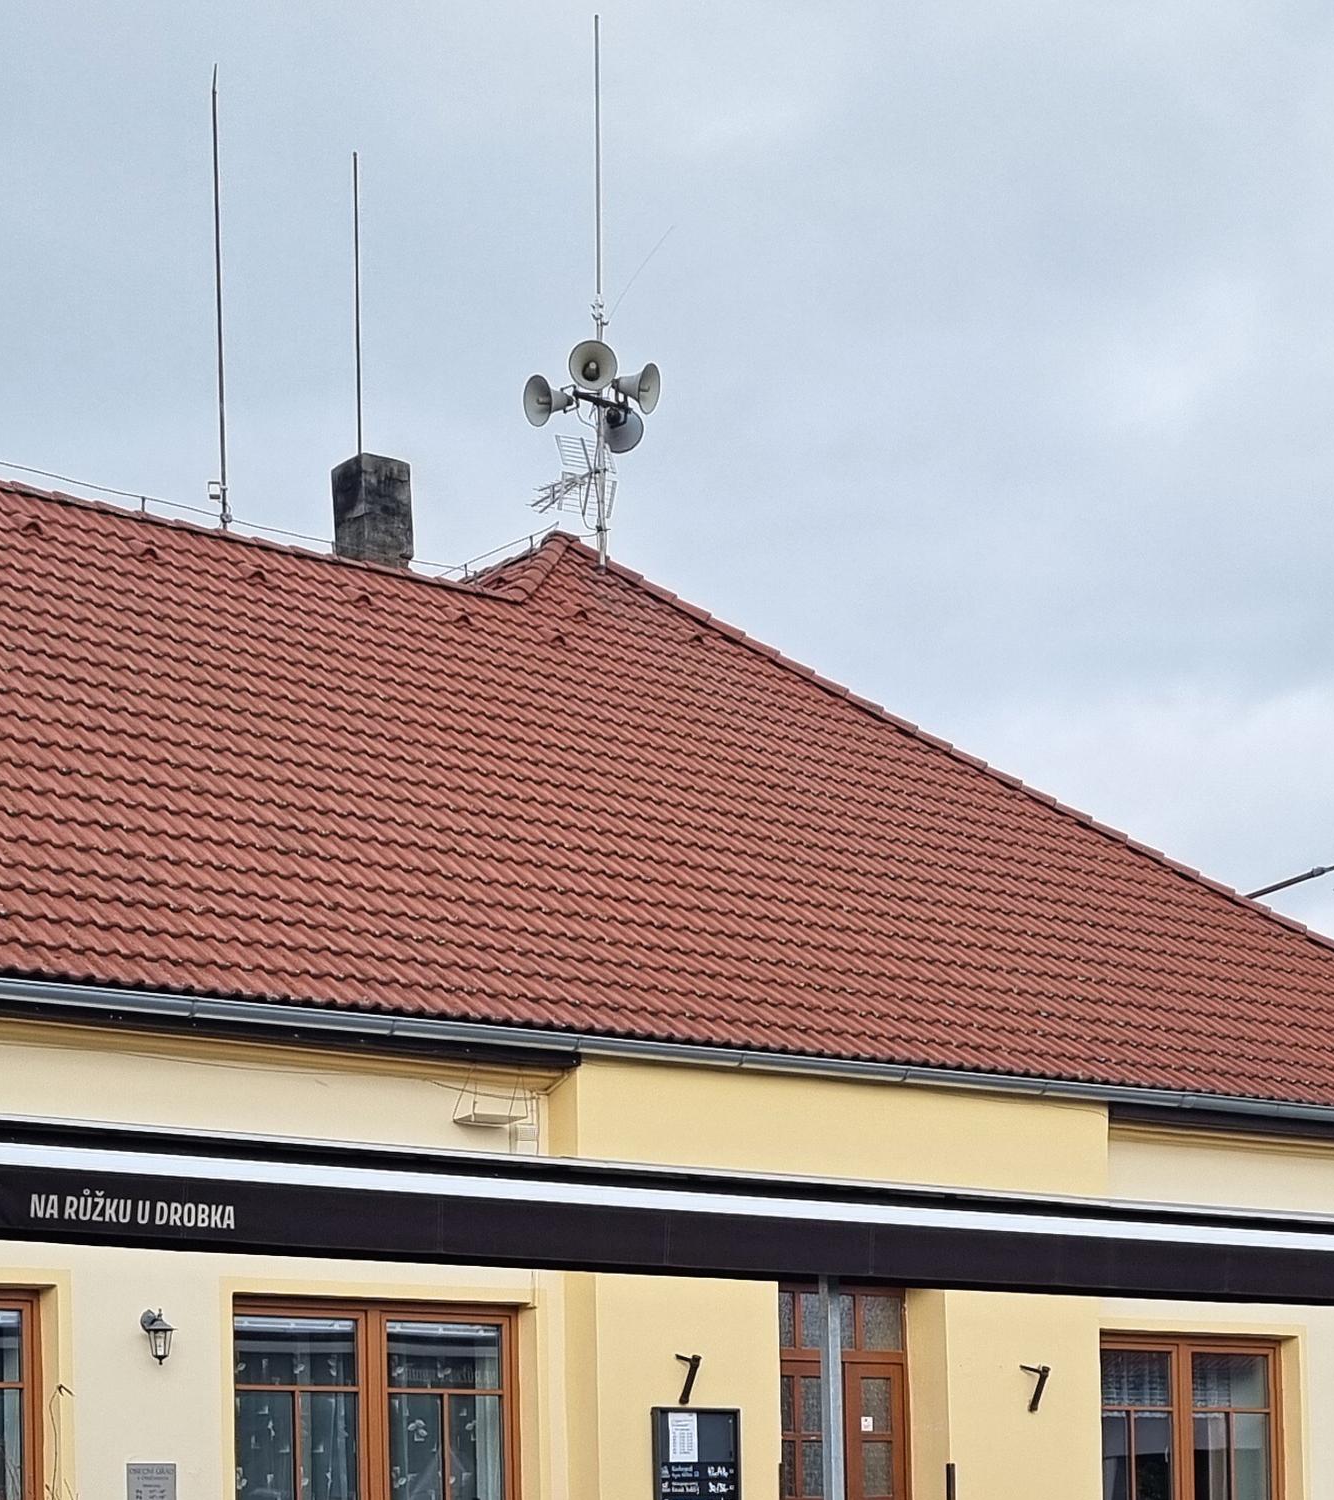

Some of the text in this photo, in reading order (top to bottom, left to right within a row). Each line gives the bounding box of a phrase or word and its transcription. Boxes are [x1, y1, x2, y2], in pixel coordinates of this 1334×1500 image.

[30, 1188, 235, 1229] NA RŮŽKU U DROBKA
[674, 1353, 702, 1405] 7
[1019, 1364, 1051, 1413] 7
